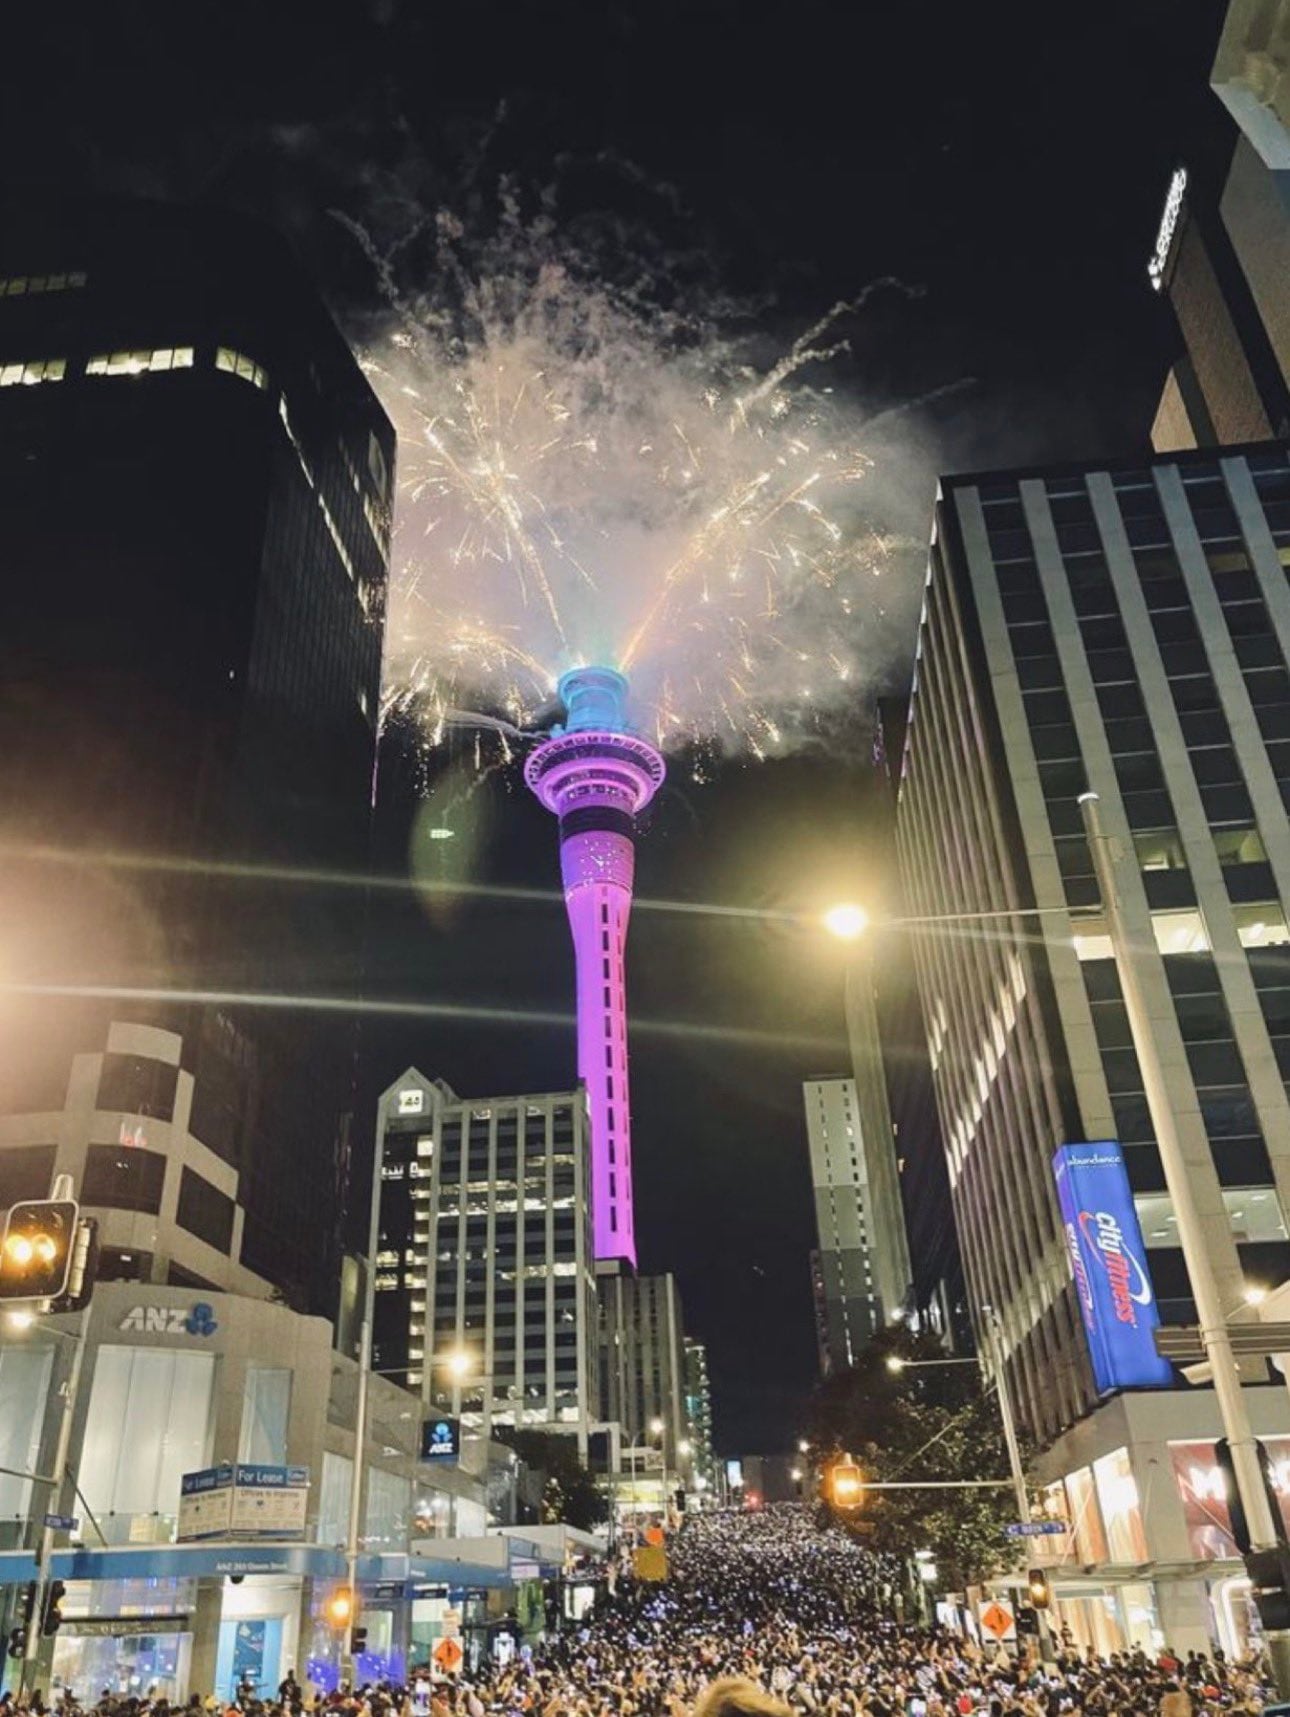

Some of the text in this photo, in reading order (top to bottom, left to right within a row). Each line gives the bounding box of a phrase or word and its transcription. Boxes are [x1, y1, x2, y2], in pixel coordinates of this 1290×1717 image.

[120, 1306, 187, 1333] ANZ
[430, 1442, 453, 1454] ANZ
[238, 1470, 254, 1482] For
[256, 1471, 284, 1484] Lease
